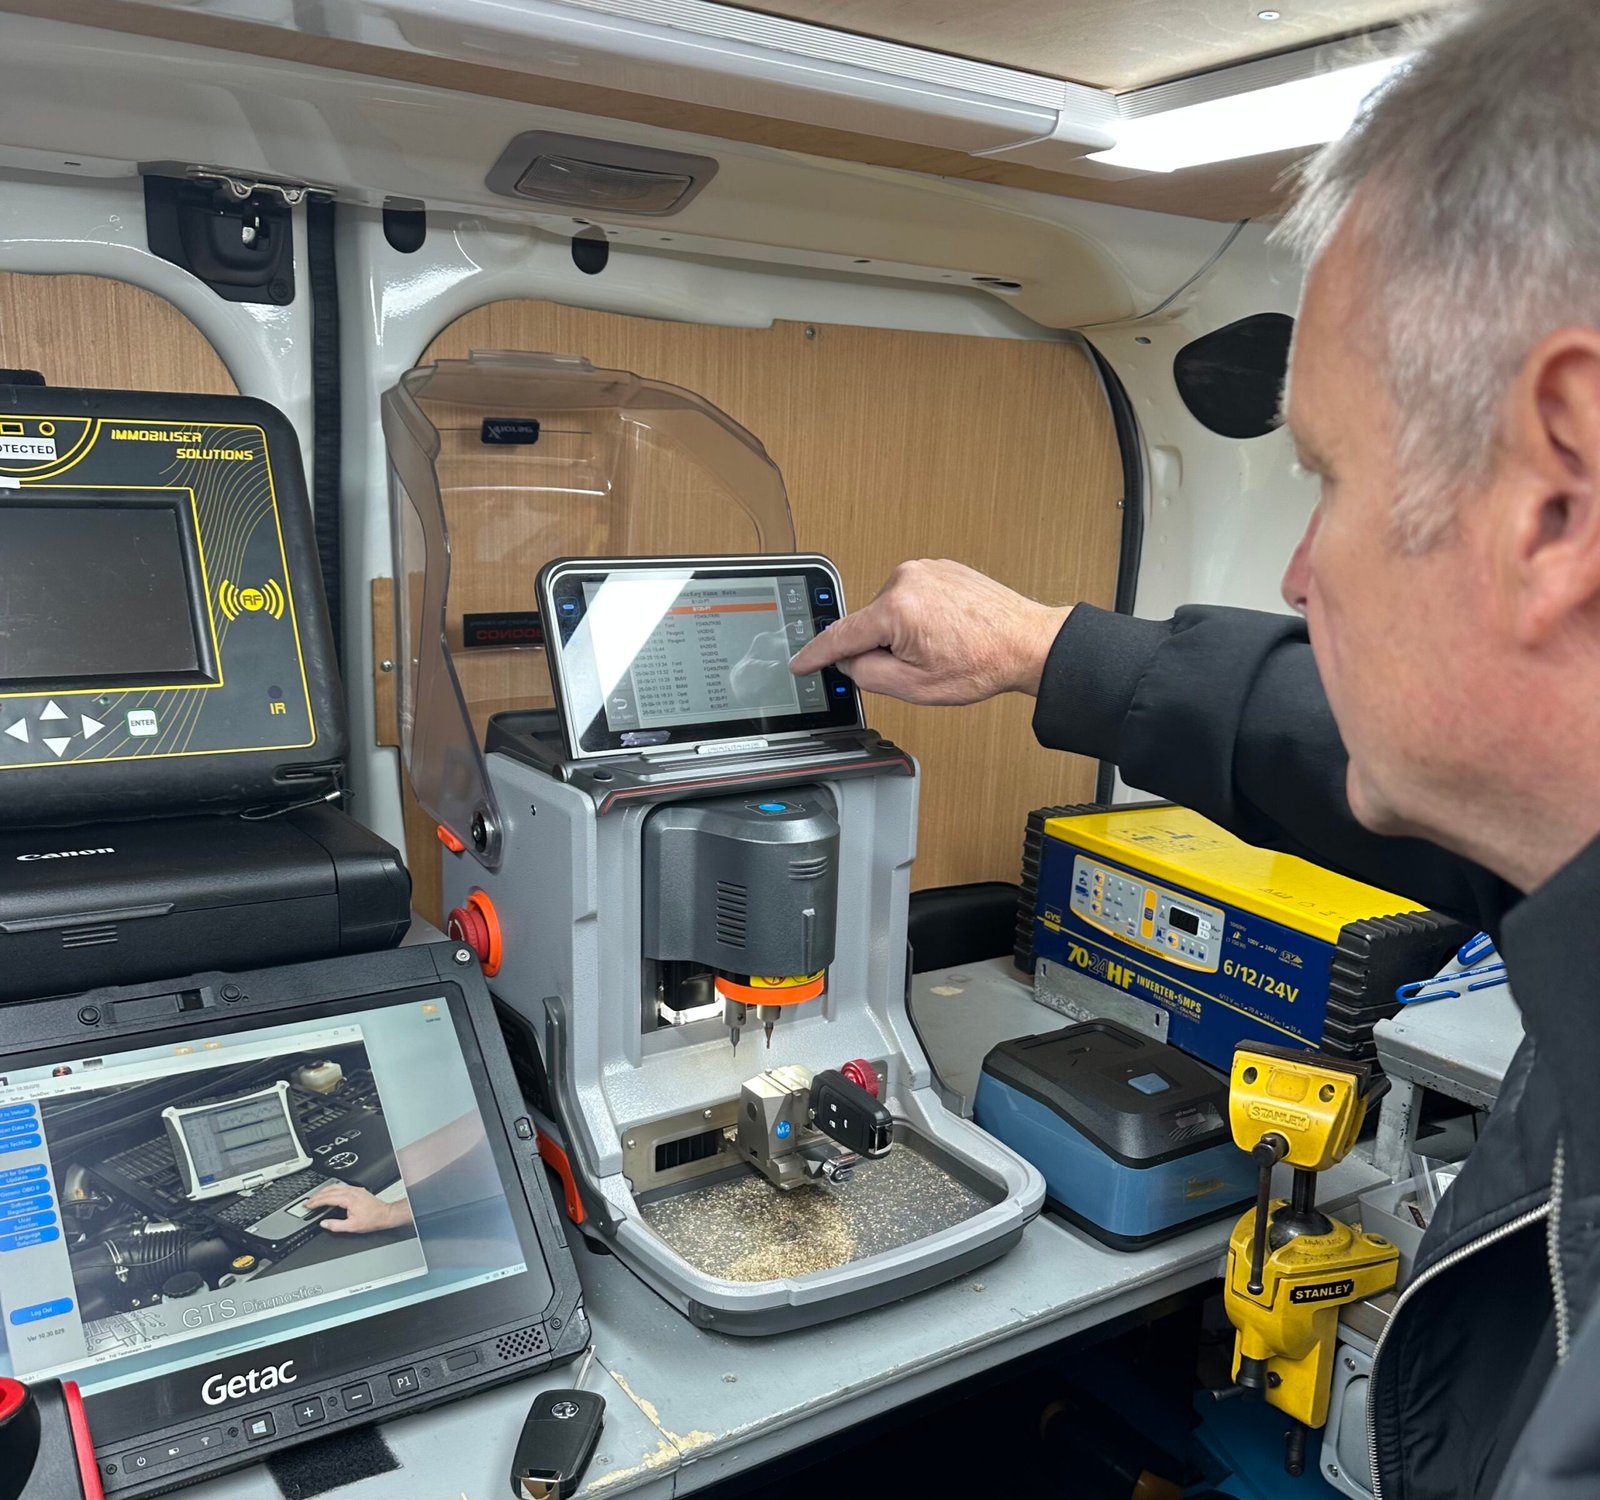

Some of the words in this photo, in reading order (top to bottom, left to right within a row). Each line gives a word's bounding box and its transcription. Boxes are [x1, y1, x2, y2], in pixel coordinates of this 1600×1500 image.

[111, 429, 202, 443] IMMOBILISER
[176, 448, 254, 461] SOLUTIONS
[242, 595, 262, 606] RF
[270, 703, 286, 715] IR
[131, 719, 155, 727] ENTER
[16, 847, 115, 861] Canon
[1045, 911, 1061, 923] GYS
[1223, 959, 1299, 1003] 6/12/24V
[1252, 1106, 1306, 1127] STANLEY
[1295, 1283, 1351, 1300] STANLEY
[182, 1299, 237, 1328] GTS
[243, 1284, 323, 1314] Diagnostics
[31, 1310, 41, 1318] Log
[201, 1360, 297, 1405] Getac
[397, 1376, 412, 1388] P1
